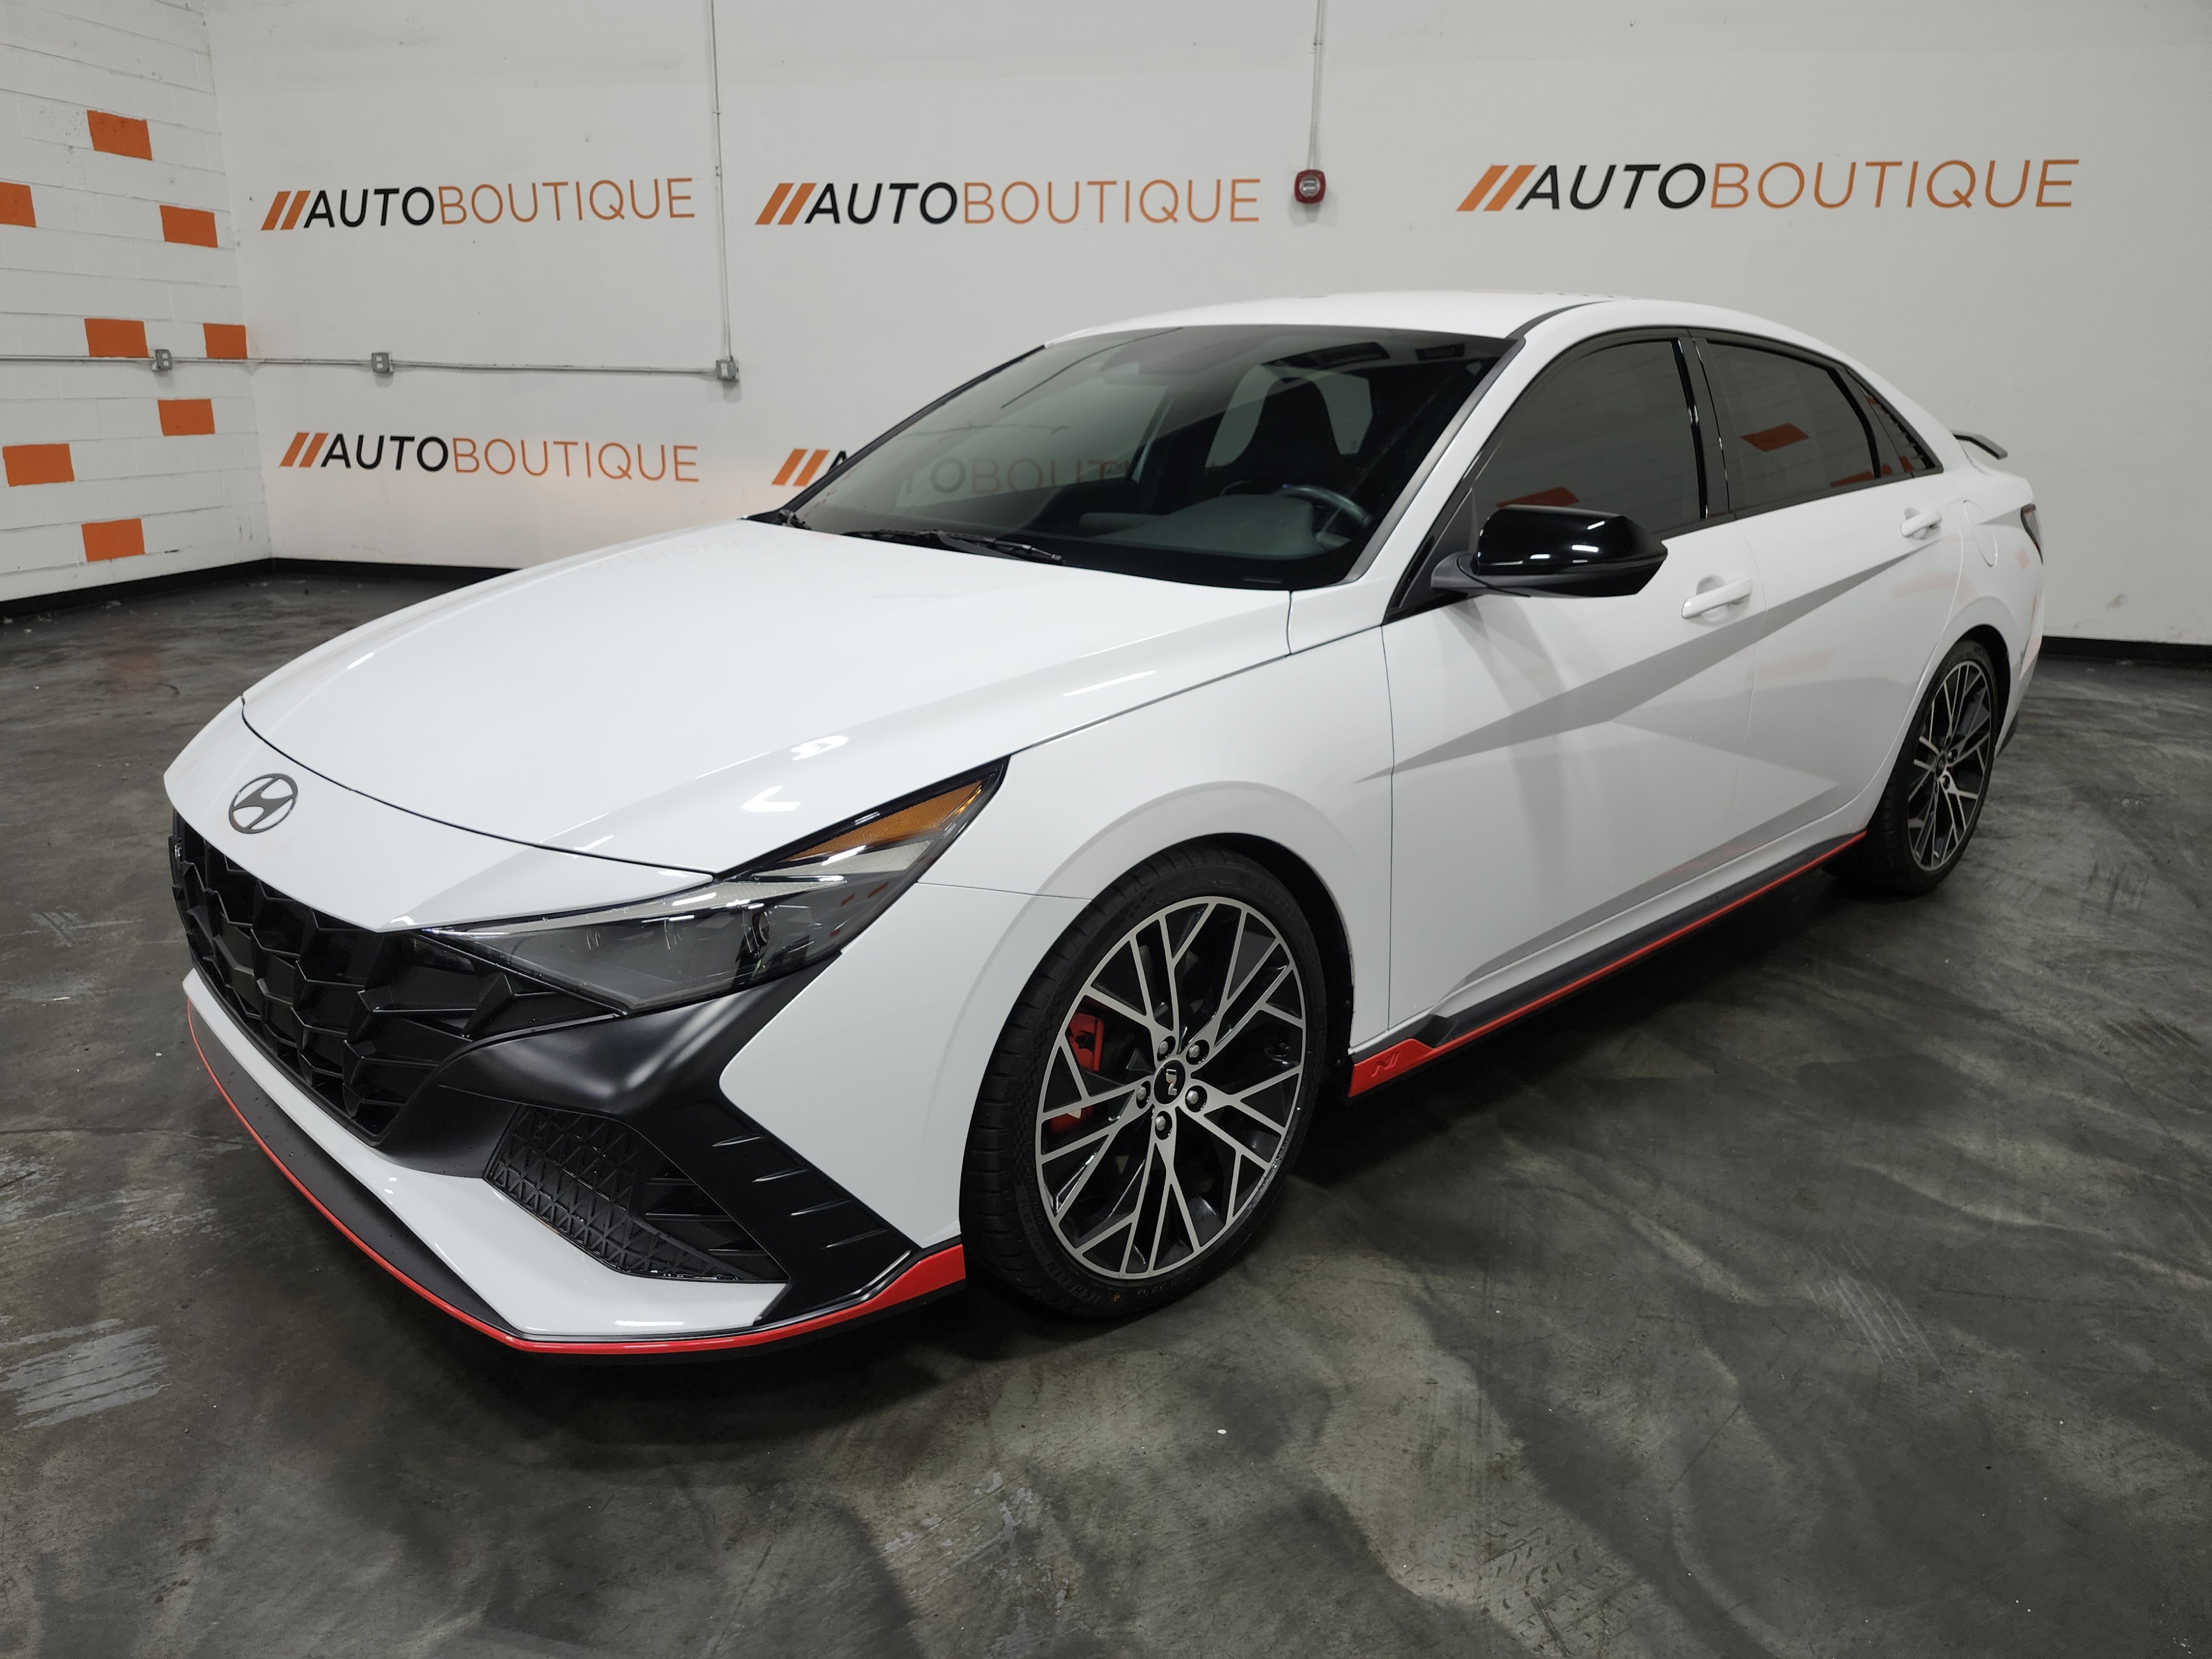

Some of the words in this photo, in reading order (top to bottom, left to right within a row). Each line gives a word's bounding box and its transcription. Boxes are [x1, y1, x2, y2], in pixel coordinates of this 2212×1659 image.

[304, 178, 695, 229] AUTOBOUTIQUE
[804, 179, 1260, 224] AUTOBOUTIQUE
[1516, 159, 2079, 211] AUTOBOUTIQUE
[321, 433, 699, 483] AUTOBOUTIQUE
